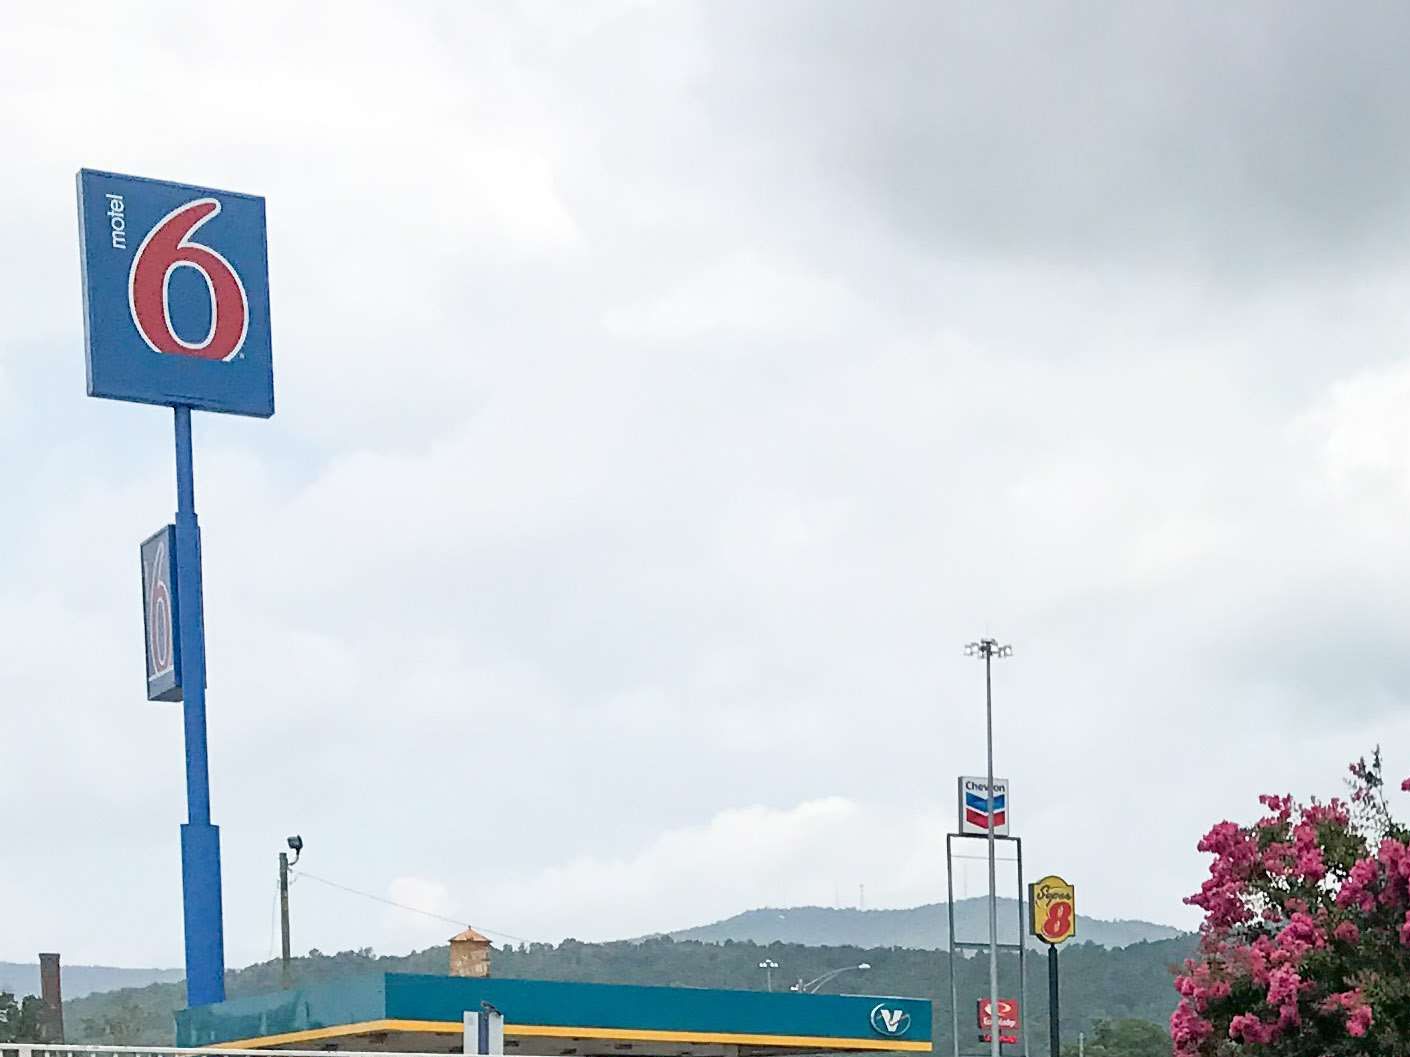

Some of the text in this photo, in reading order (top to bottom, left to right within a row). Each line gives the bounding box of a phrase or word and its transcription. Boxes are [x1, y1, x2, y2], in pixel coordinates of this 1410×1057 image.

[106, 193, 126, 249] motel
[128, 198, 250, 363] 6
[965, 780, 1006, 793] Chevon
[1042, 901, 1073, 939] 8
